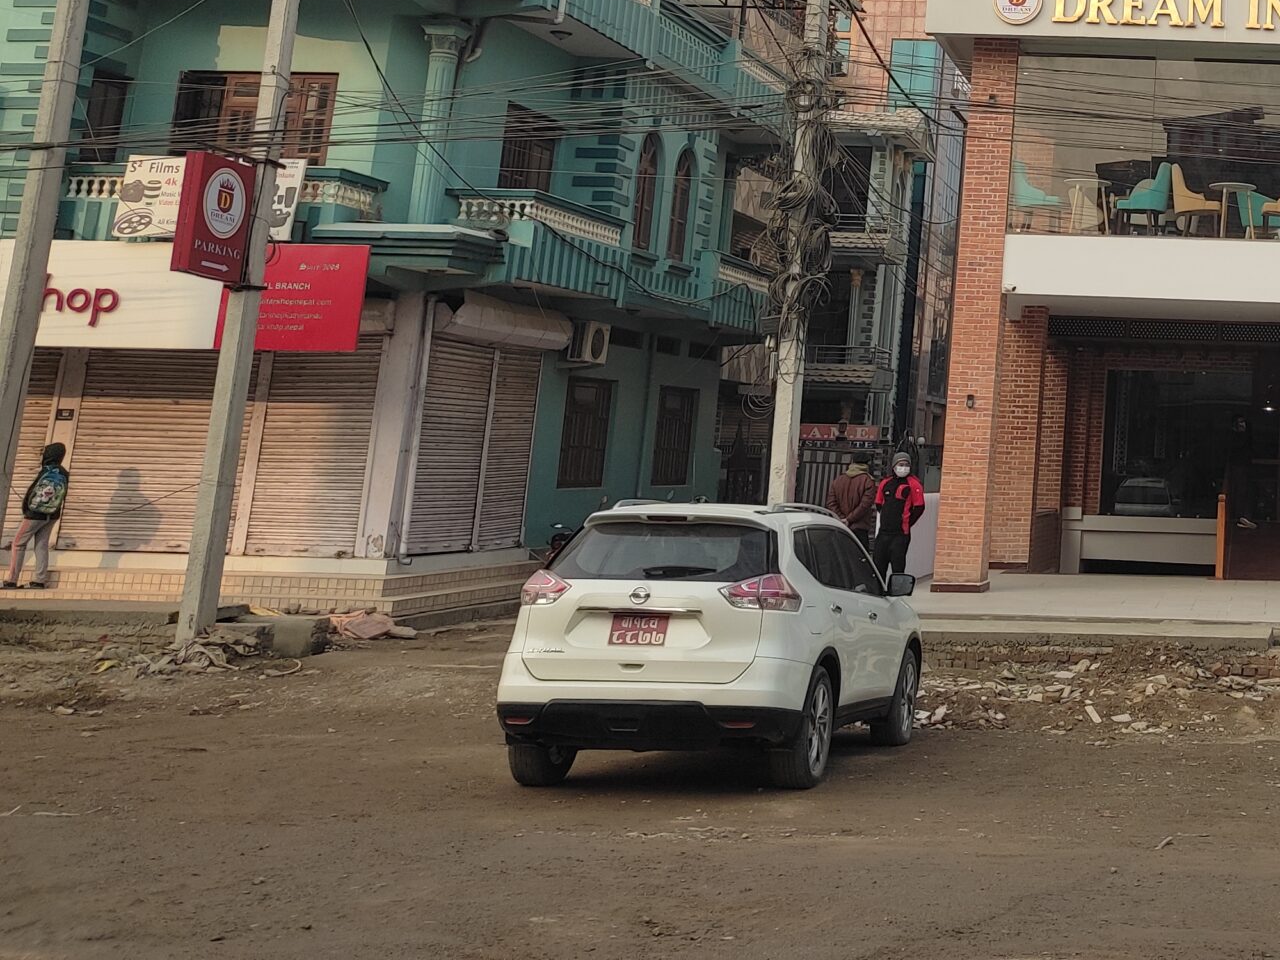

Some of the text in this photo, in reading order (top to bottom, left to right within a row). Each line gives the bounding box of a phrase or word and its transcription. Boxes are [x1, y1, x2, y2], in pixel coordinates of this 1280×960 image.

[148, 161, 181, 174] Films
[211, 211, 236, 224] DREAM
[194, 239, 240, 260] PARKING
[275, 282, 311, 290] BRANCH
